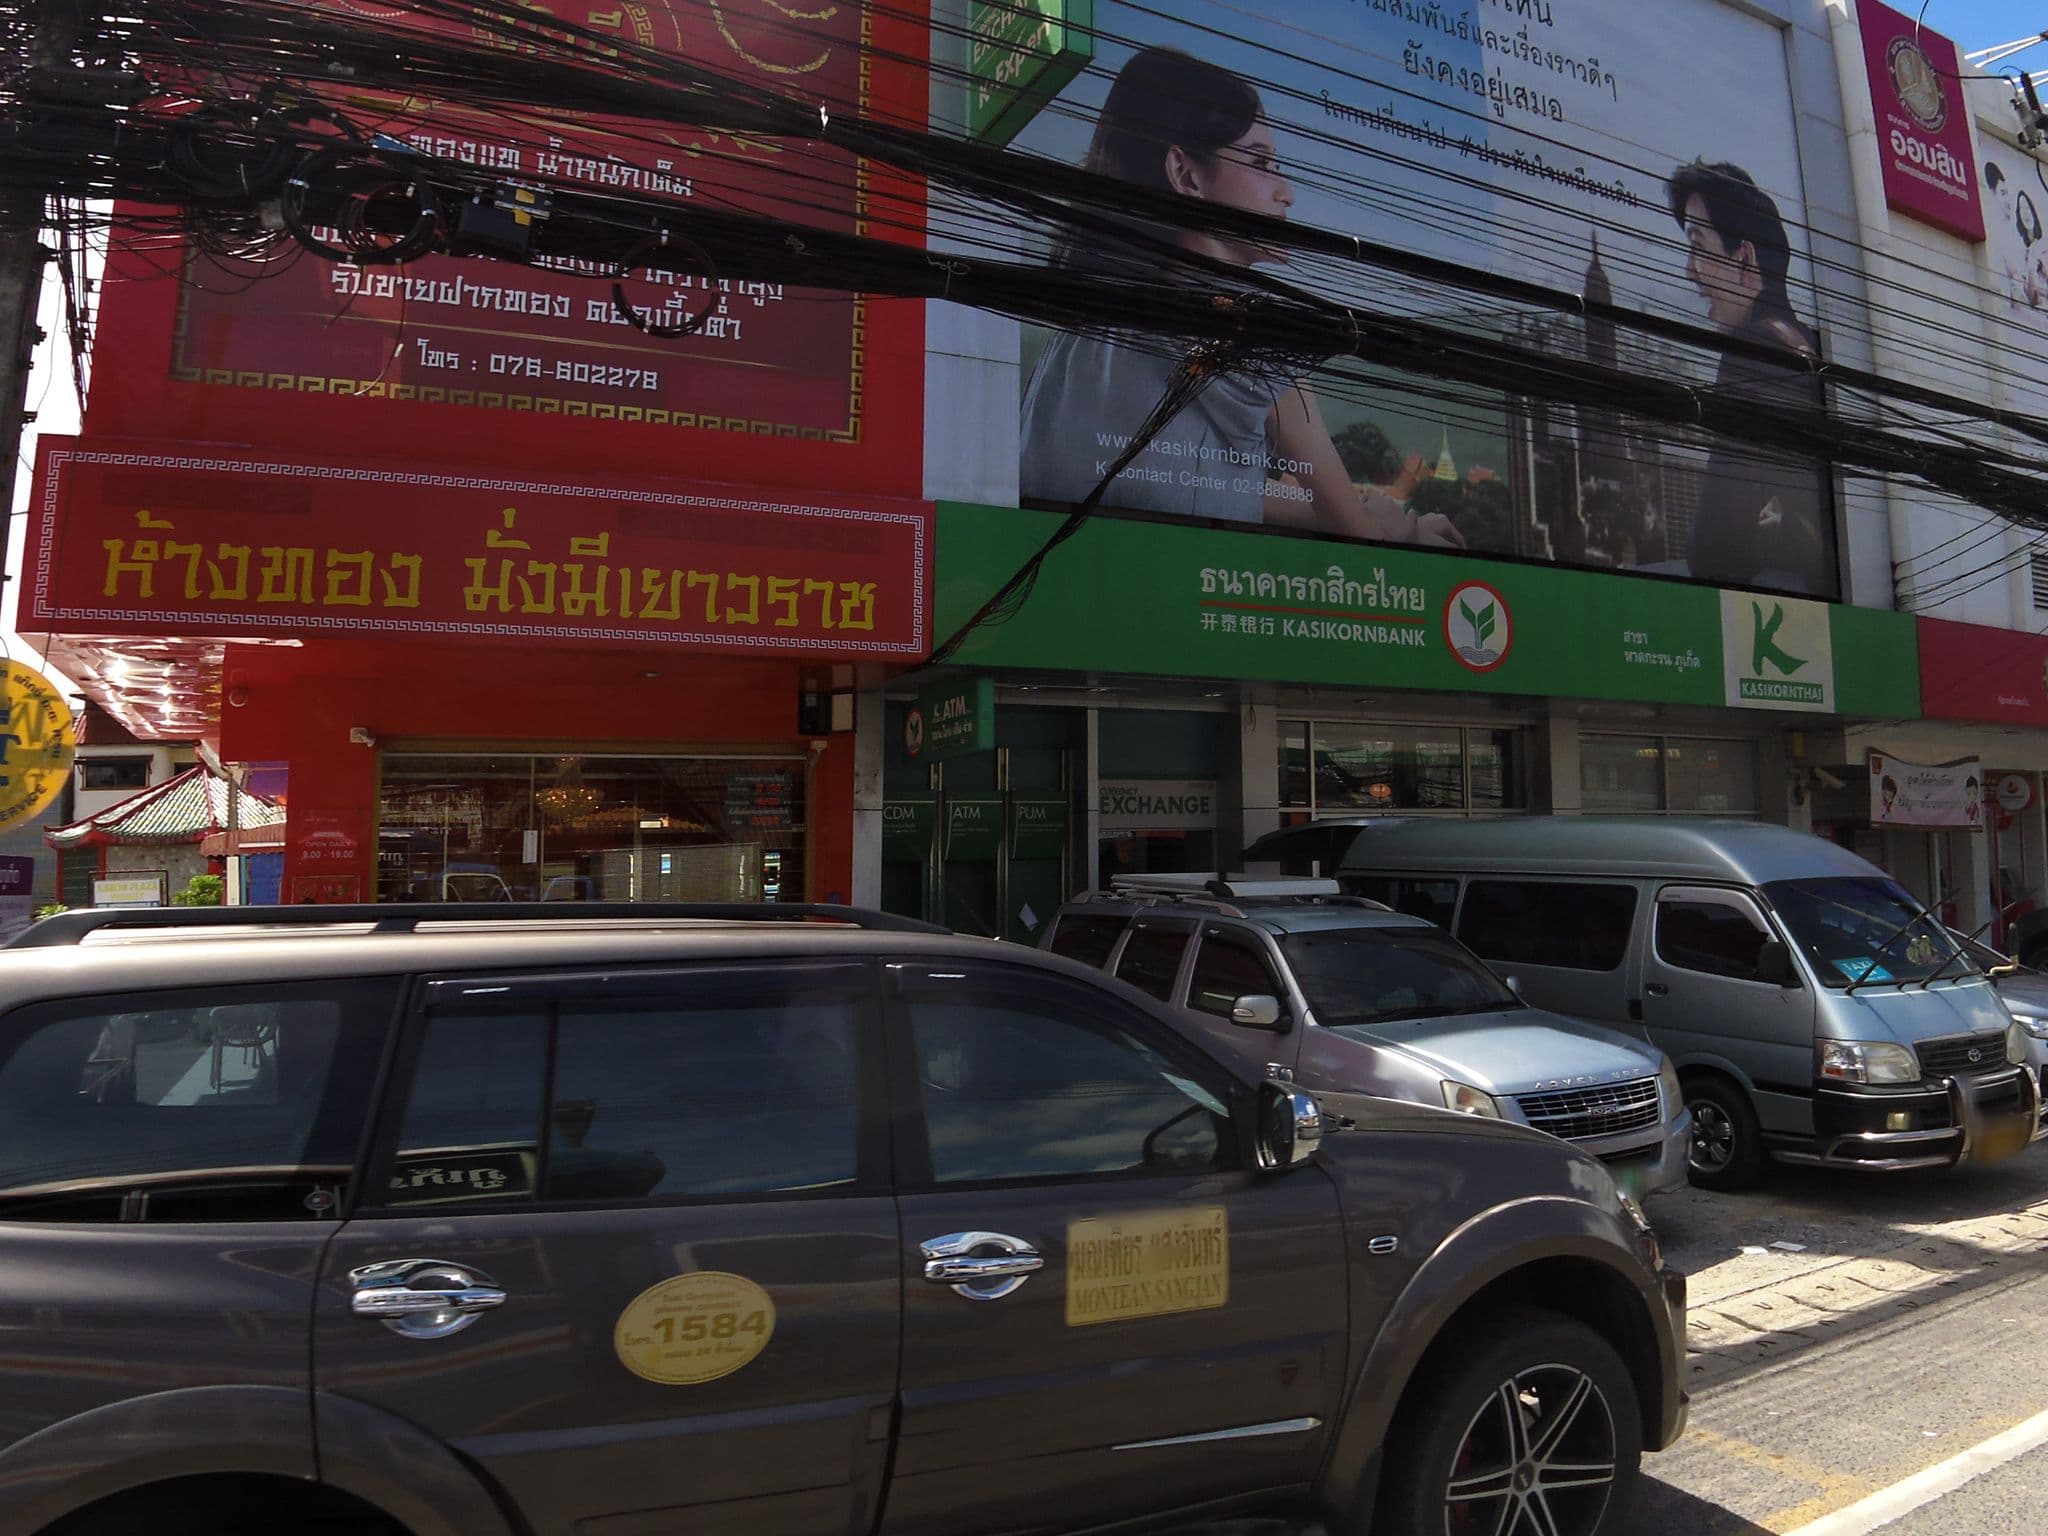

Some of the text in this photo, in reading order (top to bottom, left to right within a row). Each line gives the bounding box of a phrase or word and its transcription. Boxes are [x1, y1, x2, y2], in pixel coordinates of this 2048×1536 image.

[1403, 39, 1563, 122] ยังคงอยู่เสมอ
[1890, 129, 1967, 186] ออมสิน
[331, 262, 571, 319] รับขายฝากทอง
[417, 337, 460, 370] โทร
[489, 352, 659, 391] 076-602278
[1096, 433, 1314, 475] ww.kasikornbank.com
[1179, 471, 1228, 490] Center
[1233, 478, 1314, 503] 02-8888888
[102, 507, 878, 631] ห้างทอง มั่งมีเยาวราช
[1200, 566, 1426, 612] ธนาคารกสิกรไทย
[1200, 612, 1426, 647] 开泰银行 KASIKORNBANK
[1623, 630, 1648, 645] สาขา
[1675, 649, 1701, 673] ภูเก็ต
[1741, 681, 1823, 702] KASIKORNTHAI
[943, 696, 966, 720] ATM
[884, 806, 915, 820] CDM
[952, 806, 981, 820] ATM
[1018, 806, 1046, 820] PUM
[1099, 796, 1209, 814] EXCHANGE
[1535, 1068, 1641, 1090] ADVENURE
[653, 1310, 767, 1344] 1584
